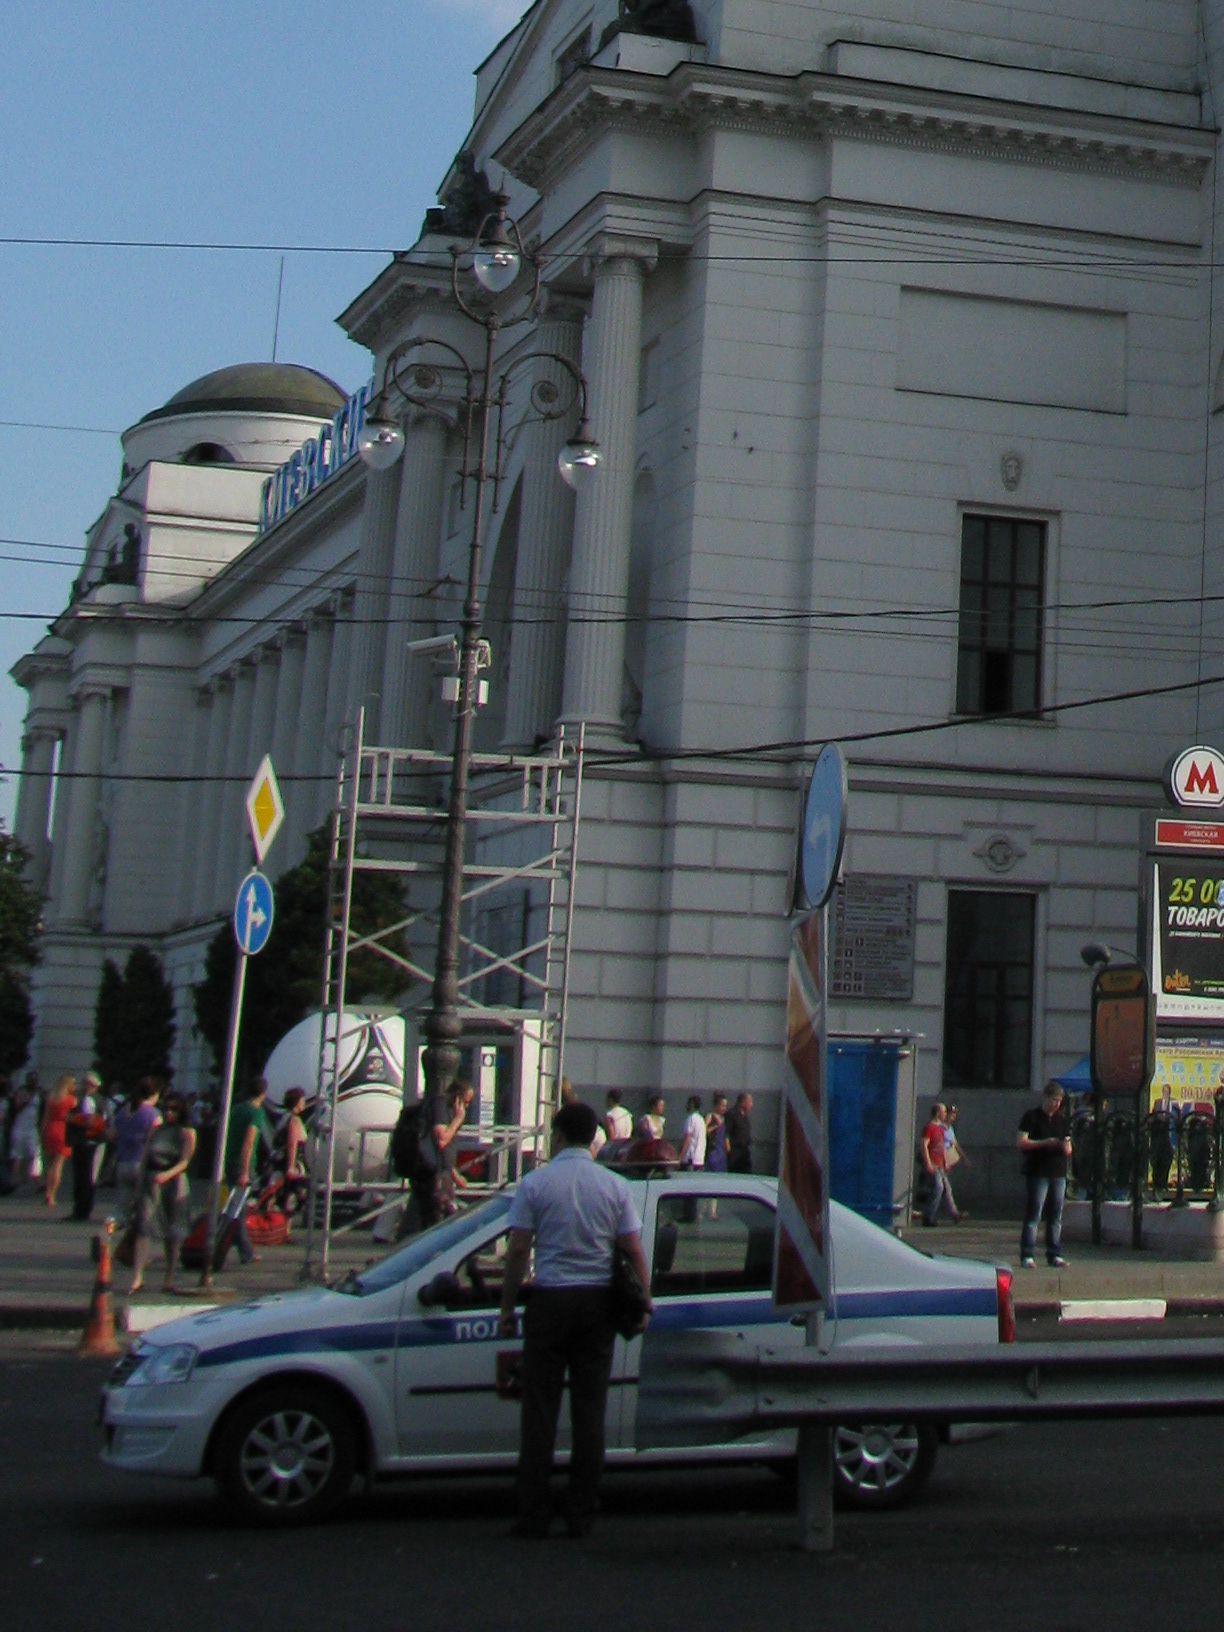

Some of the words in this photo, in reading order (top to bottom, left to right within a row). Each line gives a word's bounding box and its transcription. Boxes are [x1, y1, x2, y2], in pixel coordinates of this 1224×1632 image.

[1184, 760, 1219, 794] М
[1183, 830, 1218, 838] КИЕВСКАЯ
[1169, 878, 1196, 904] 25
